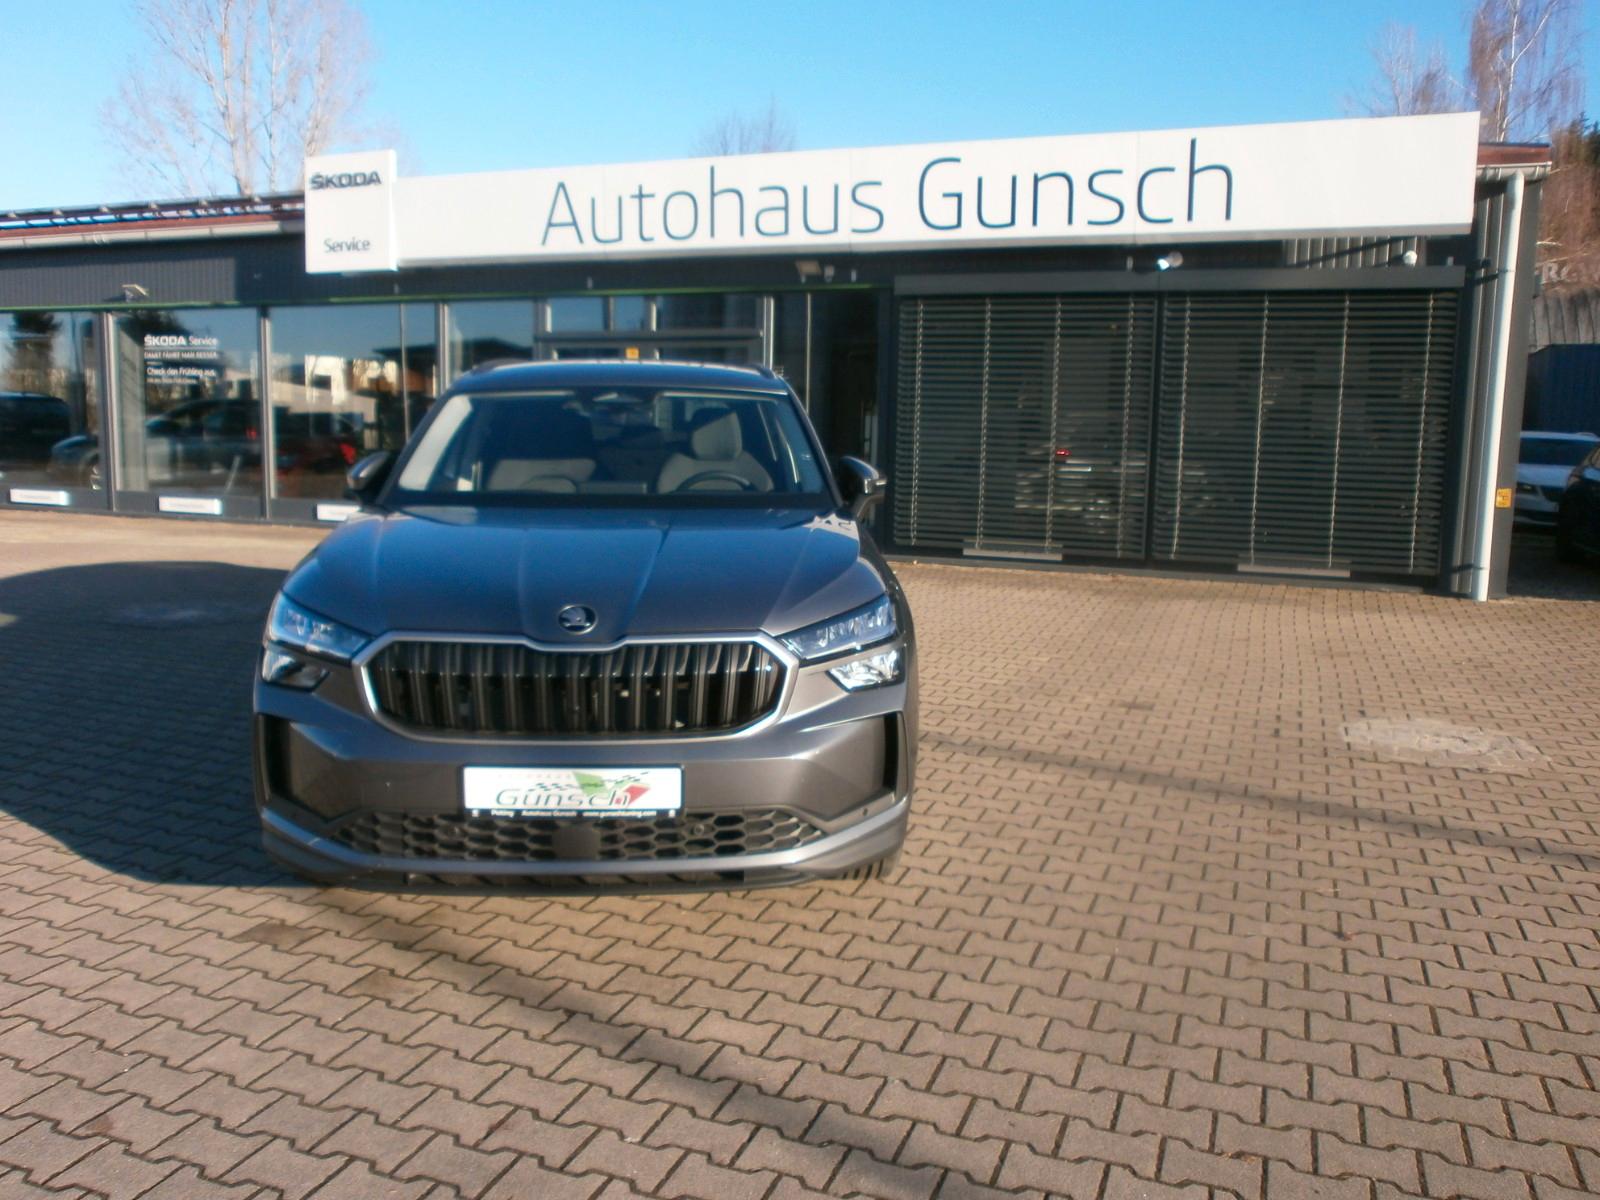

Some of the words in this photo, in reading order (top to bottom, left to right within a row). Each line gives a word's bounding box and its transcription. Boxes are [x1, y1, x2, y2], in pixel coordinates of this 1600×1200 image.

[309, 171, 382, 190] ŠKODA
[541, 165, 884, 246] Autohaus
[918, 138, 1233, 230] Gunsch
[324, 236, 371, 253] Service
[144, 334, 187, 346] ŠKODA
[189, 335, 217, 346] Service
